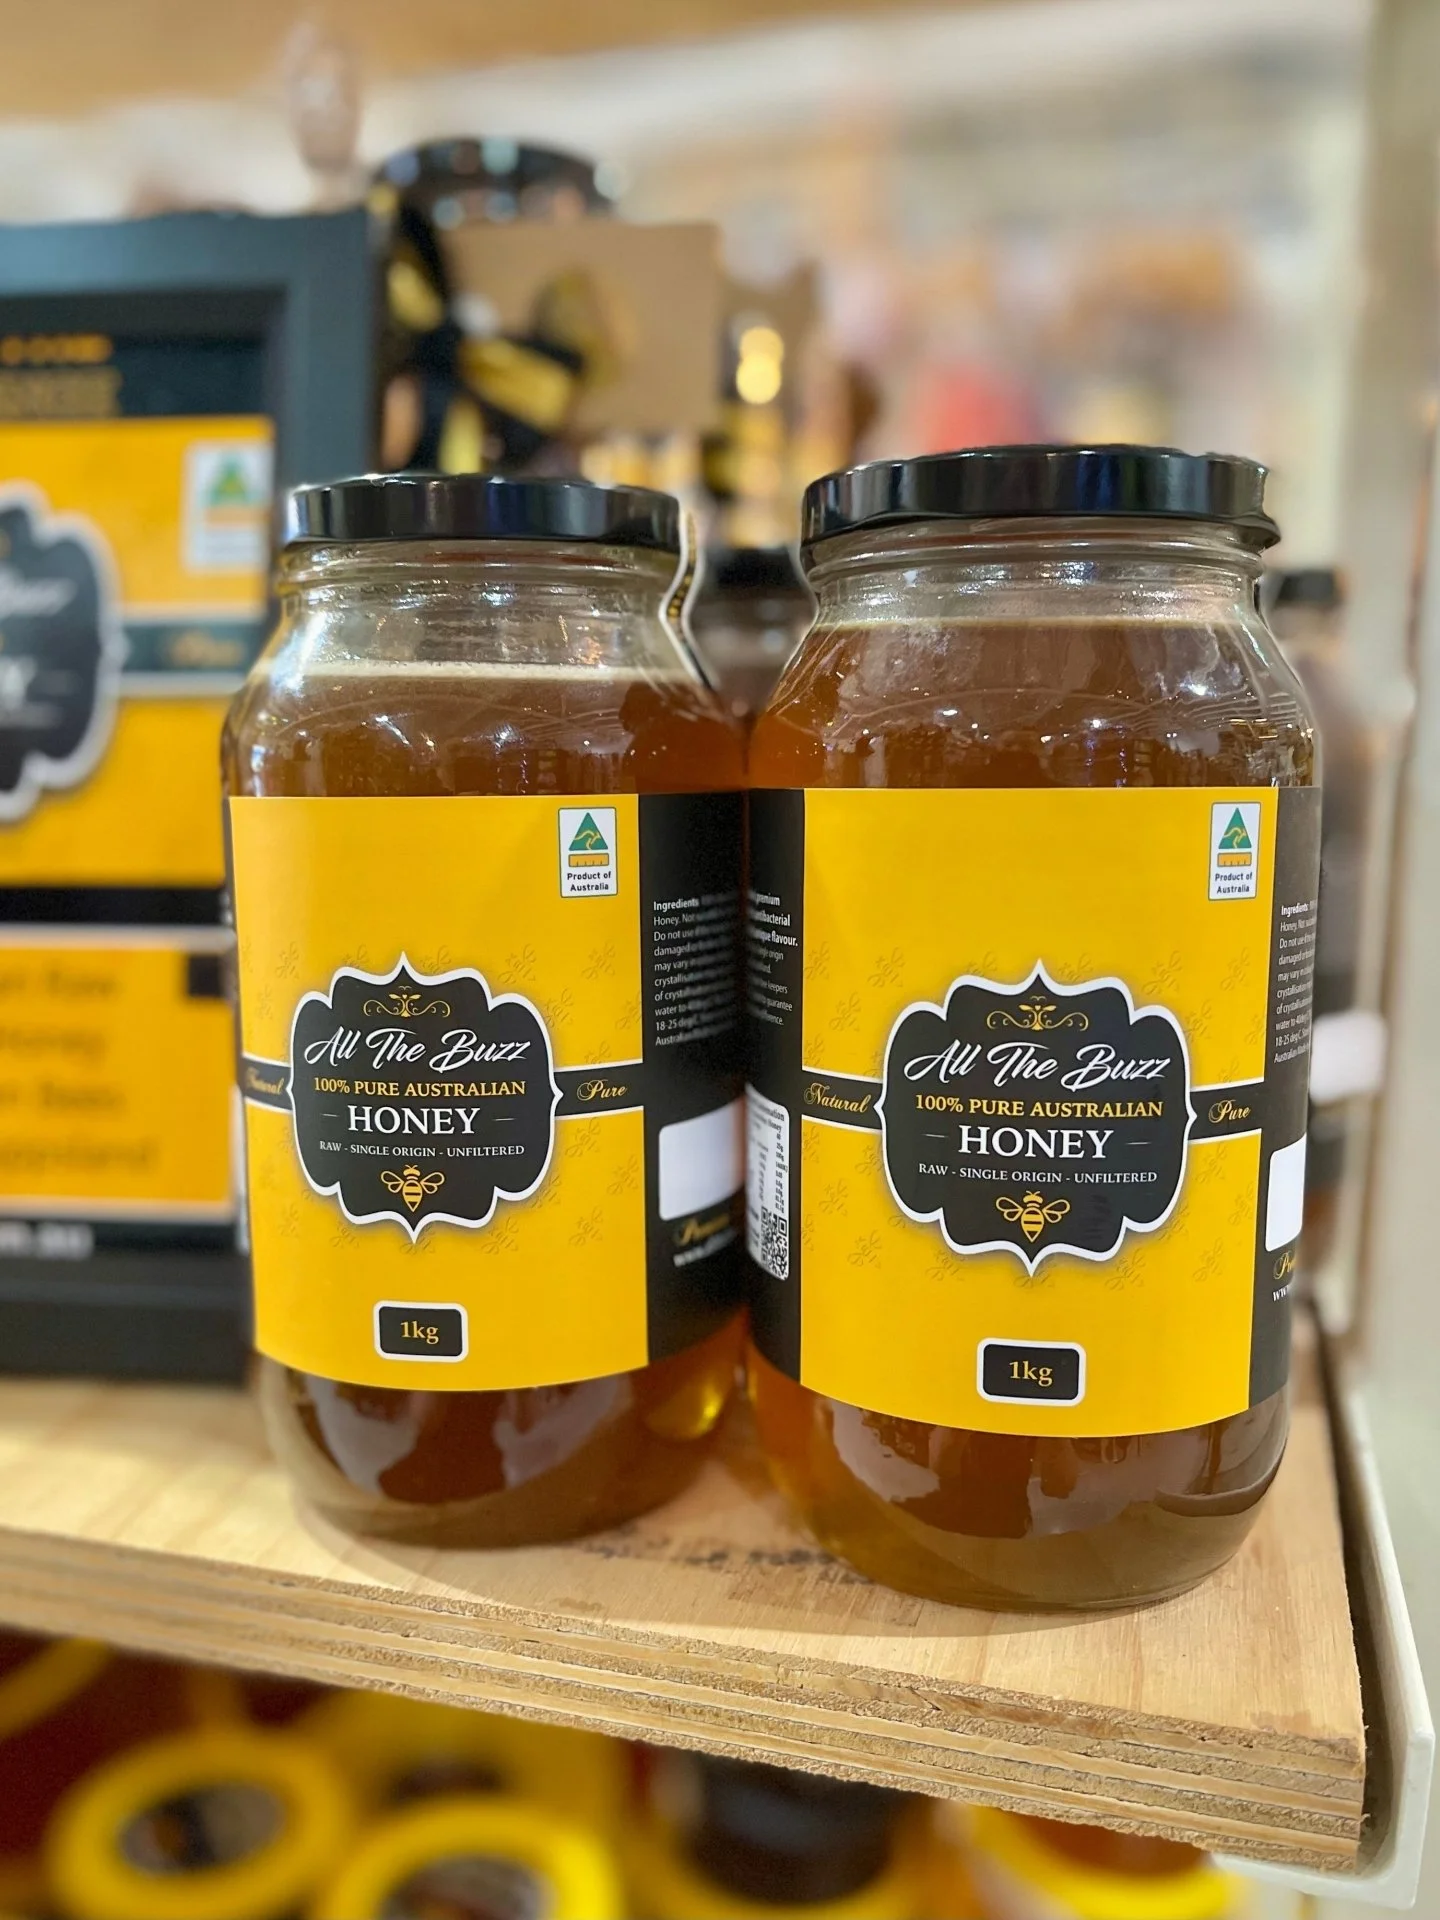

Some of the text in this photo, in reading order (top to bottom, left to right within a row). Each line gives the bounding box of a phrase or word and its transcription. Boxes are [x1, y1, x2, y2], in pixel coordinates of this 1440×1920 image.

[567, 870, 612, 881] Product of
[1214, 871, 1253, 882] Product of
[570, 882, 609, 892] Australia
[1216, 884, 1250, 894] Australia
[653, 931, 666, 942] Do
[667, 930, 681, 940] not
[771, 930, 798, 947] flavour.
[653, 942, 690, 957] damaged
[654, 959, 688, 973] may vary
[654, 991, 664, 1002] of
[654, 1006, 677, 1017] water
[656, 1018, 677, 1031] 18-25
[304, 1026, 531, 1074] All The Buzz
[903, 1039, 1171, 1092] All The Buzz
[314, 1077, 526, 1098] 100% PURE AUSTRALIAN
[576, 1078, 628, 1101] Pure
[804, 1082, 872, 1113] Natural
[915, 1094, 1164, 1118] 100% PURE AUSTRALIAN
[347, 1105, 480, 1135] HONEY
[1208, 1099, 1251, 1124] Pure
[319, 1141, 342, 1152] RAW
[350, 1144, 390, 1157] SINGLE
[392, 1146, 436, 1157] ORIGIN
[447, 1145, 525, 1157] UNFILTERED
[958, 1124, 1115, 1159] HONEY
[918, 1163, 949, 1176] RAW
[959, 1167, 1008, 1181] SINGLE
[1011, 1171, 1063, 1183] ORIGIN
[1074, 1172, 1158, 1184] UNFILTERED
[400, 1320, 439, 1345] 1kg
[1009, 1360, 1053, 1387] 1kg
